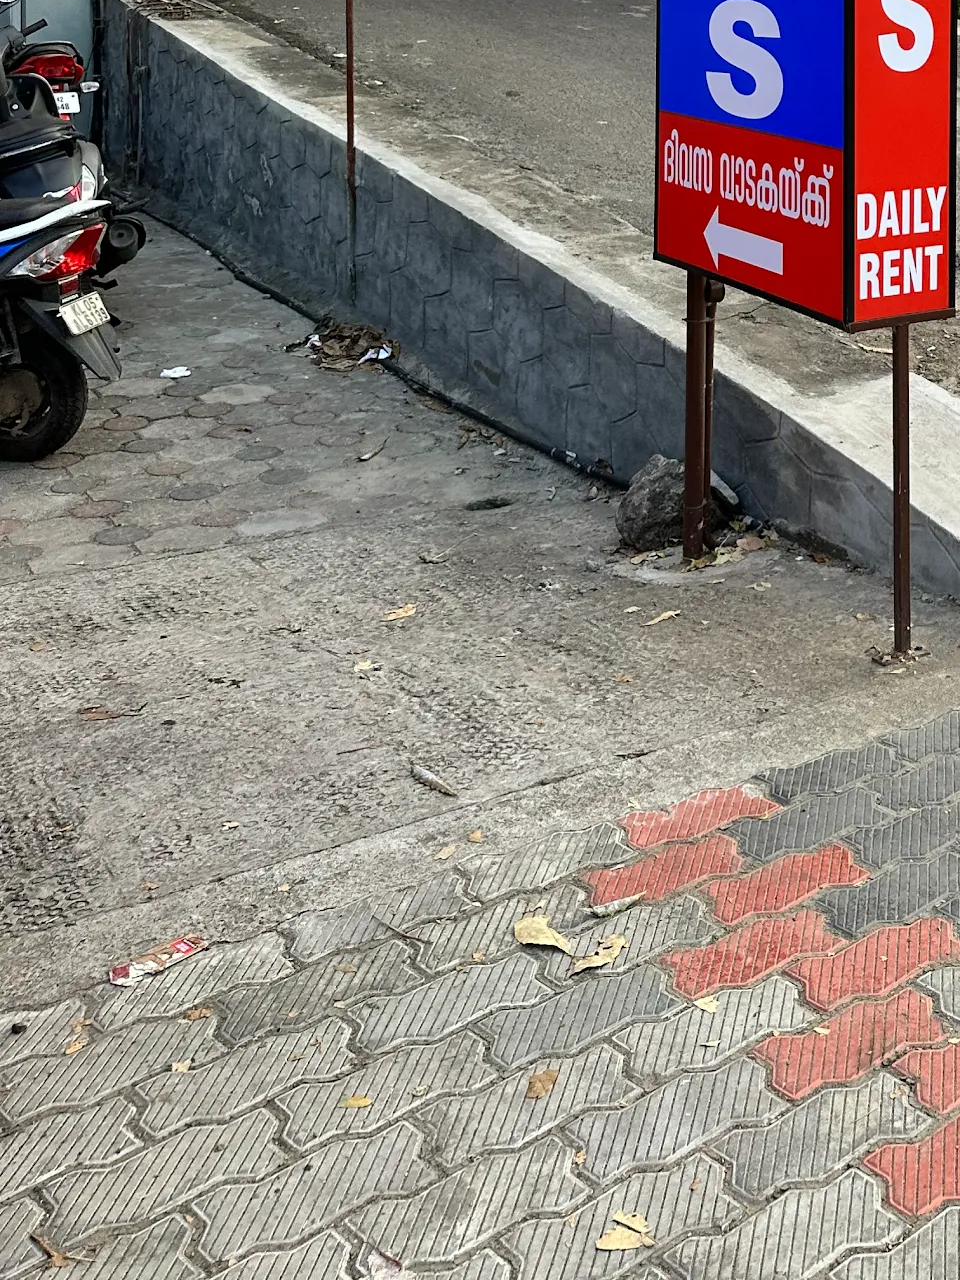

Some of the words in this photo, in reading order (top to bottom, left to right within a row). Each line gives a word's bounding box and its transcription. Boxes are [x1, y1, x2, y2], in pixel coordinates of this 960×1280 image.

[664, 128, 713, 194] ദിവസ
[719, 156, 834, 229] വാടകയ്ക്ക്
[857, 186, 947, 240] DAILY
[859, 245, 943, 300] RENT
